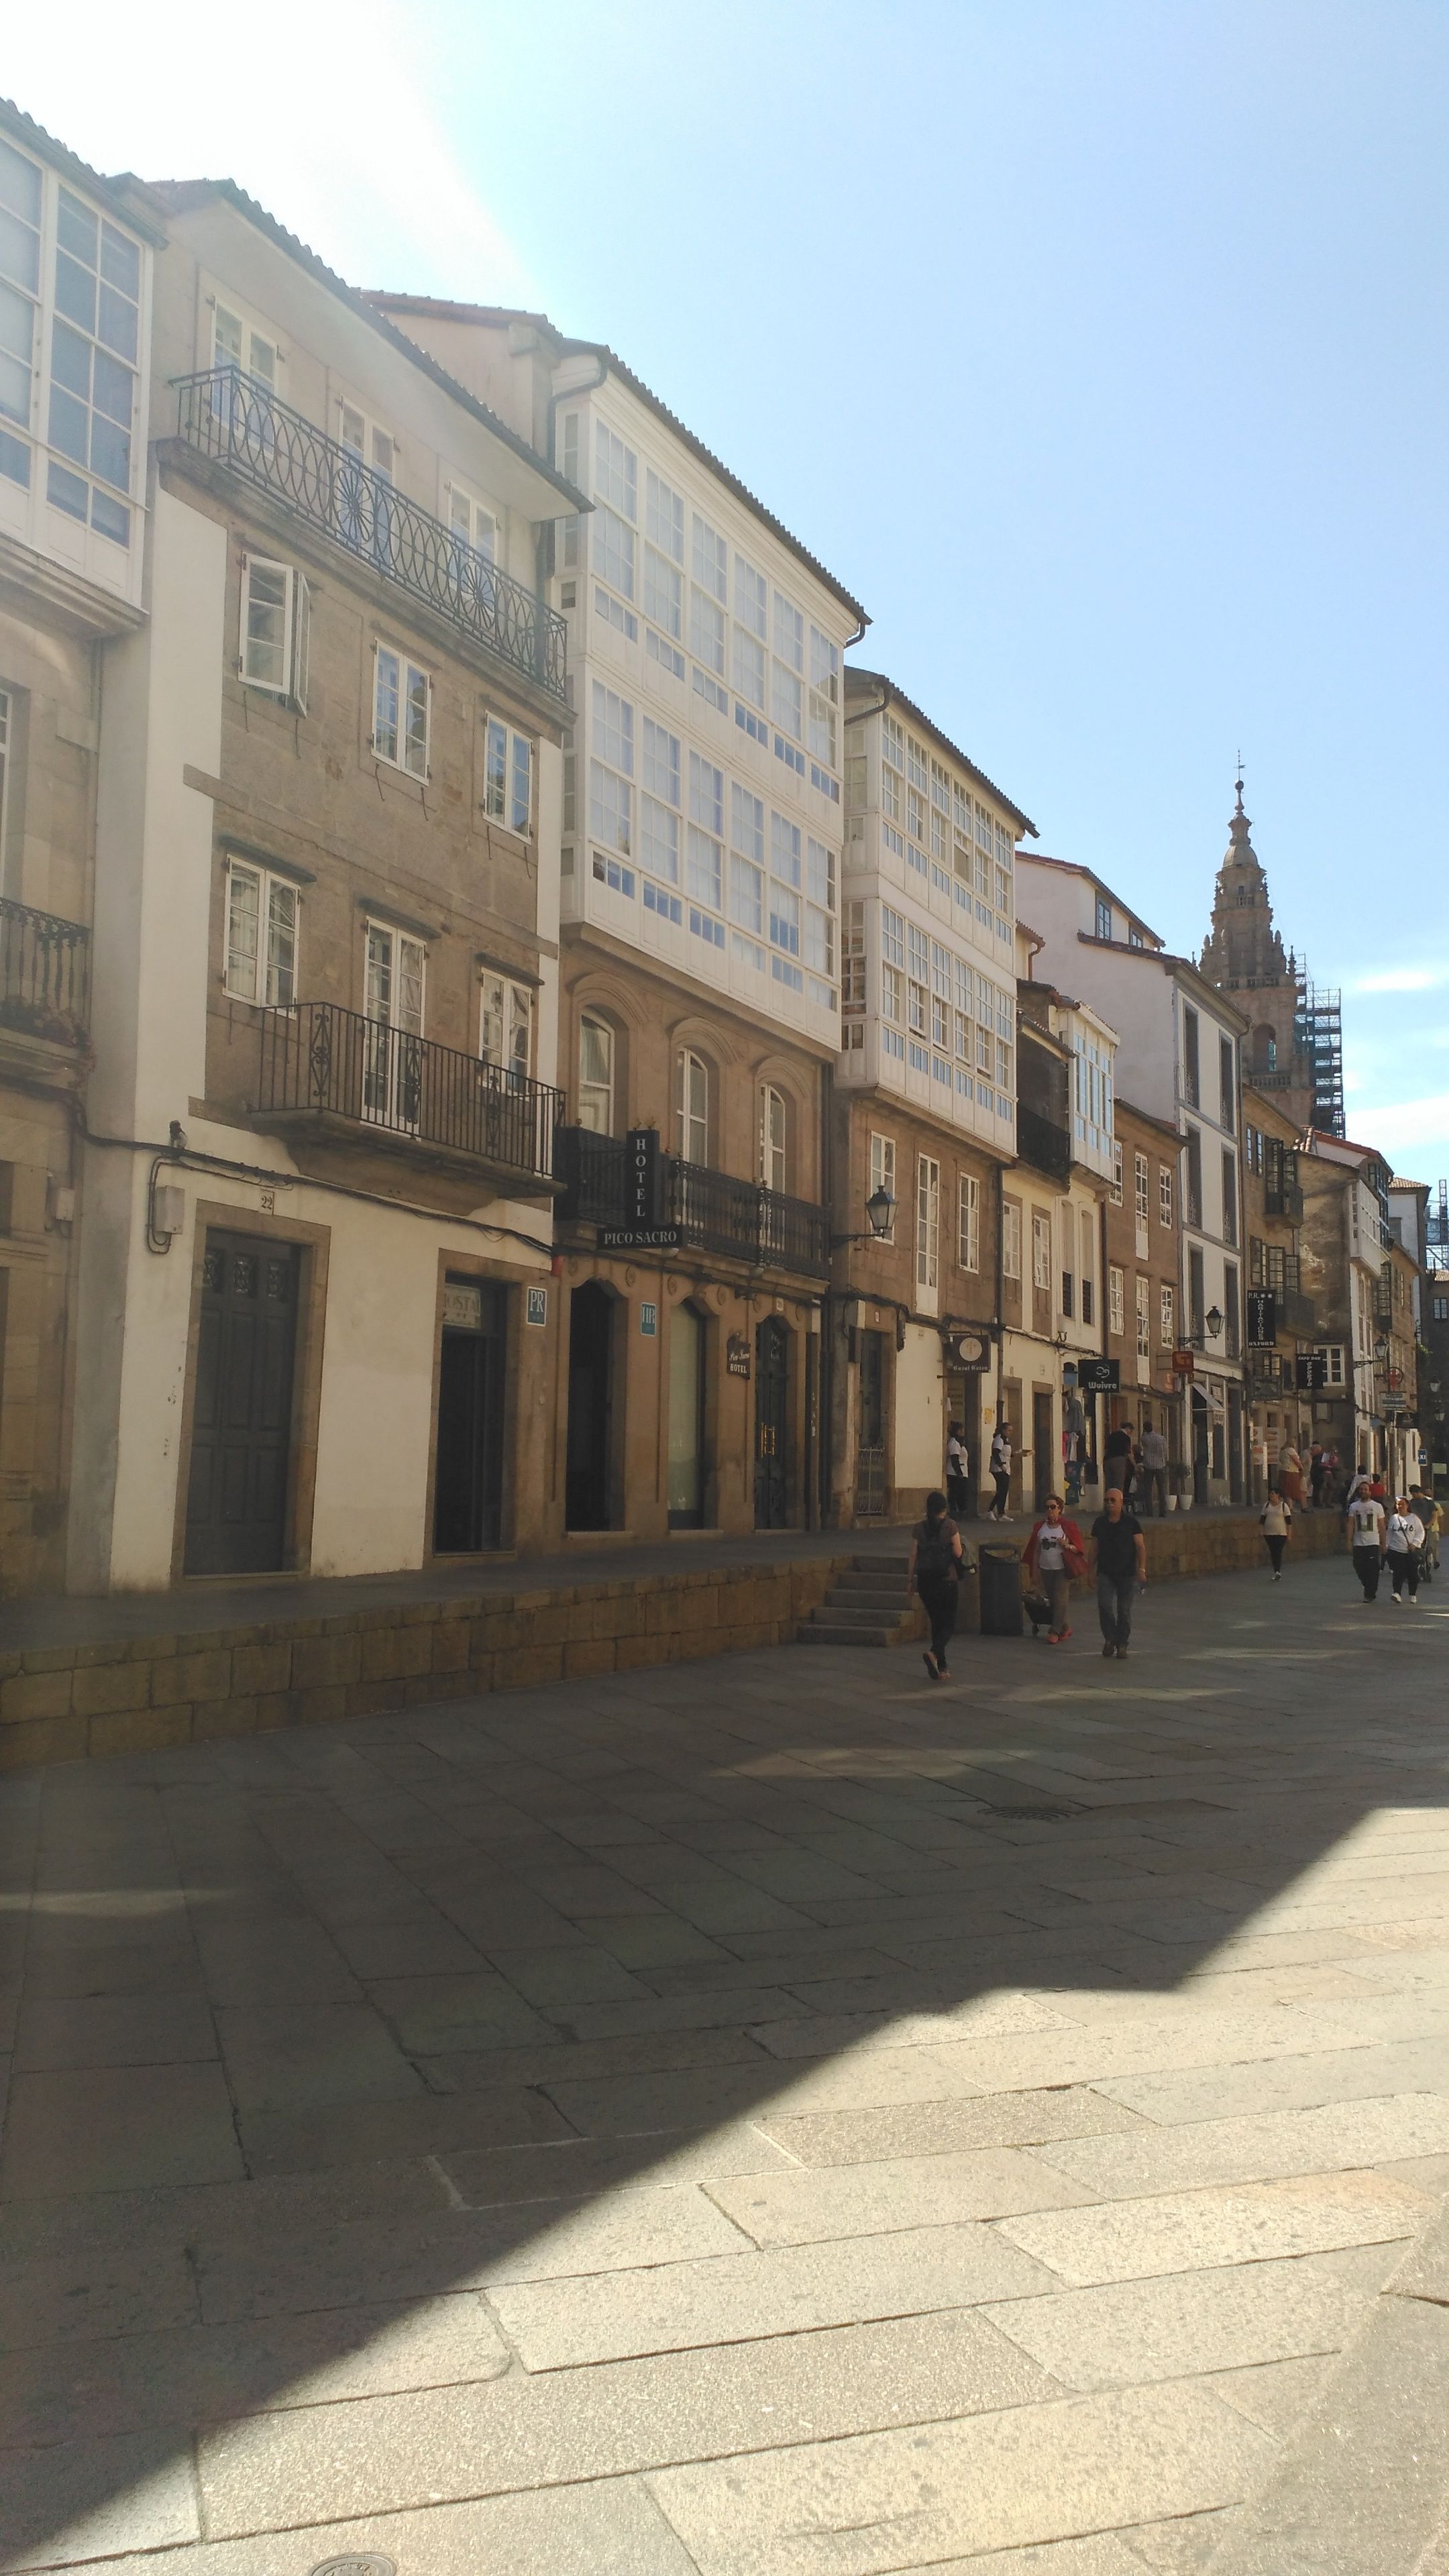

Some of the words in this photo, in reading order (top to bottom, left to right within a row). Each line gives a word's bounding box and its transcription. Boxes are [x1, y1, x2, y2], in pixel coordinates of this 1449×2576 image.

[635, 1138, 647, 1217] HOTEL
[261, 1195, 272, 1210] 22
[604, 1232, 633, 1244] PICO
[635, 1230, 678, 1243] SACRO
[529, 1290, 543, 1312] PR
[730, 1363, 748, 1374] HOTEL
[1088, 1381, 1118, 1389] Wuivre
